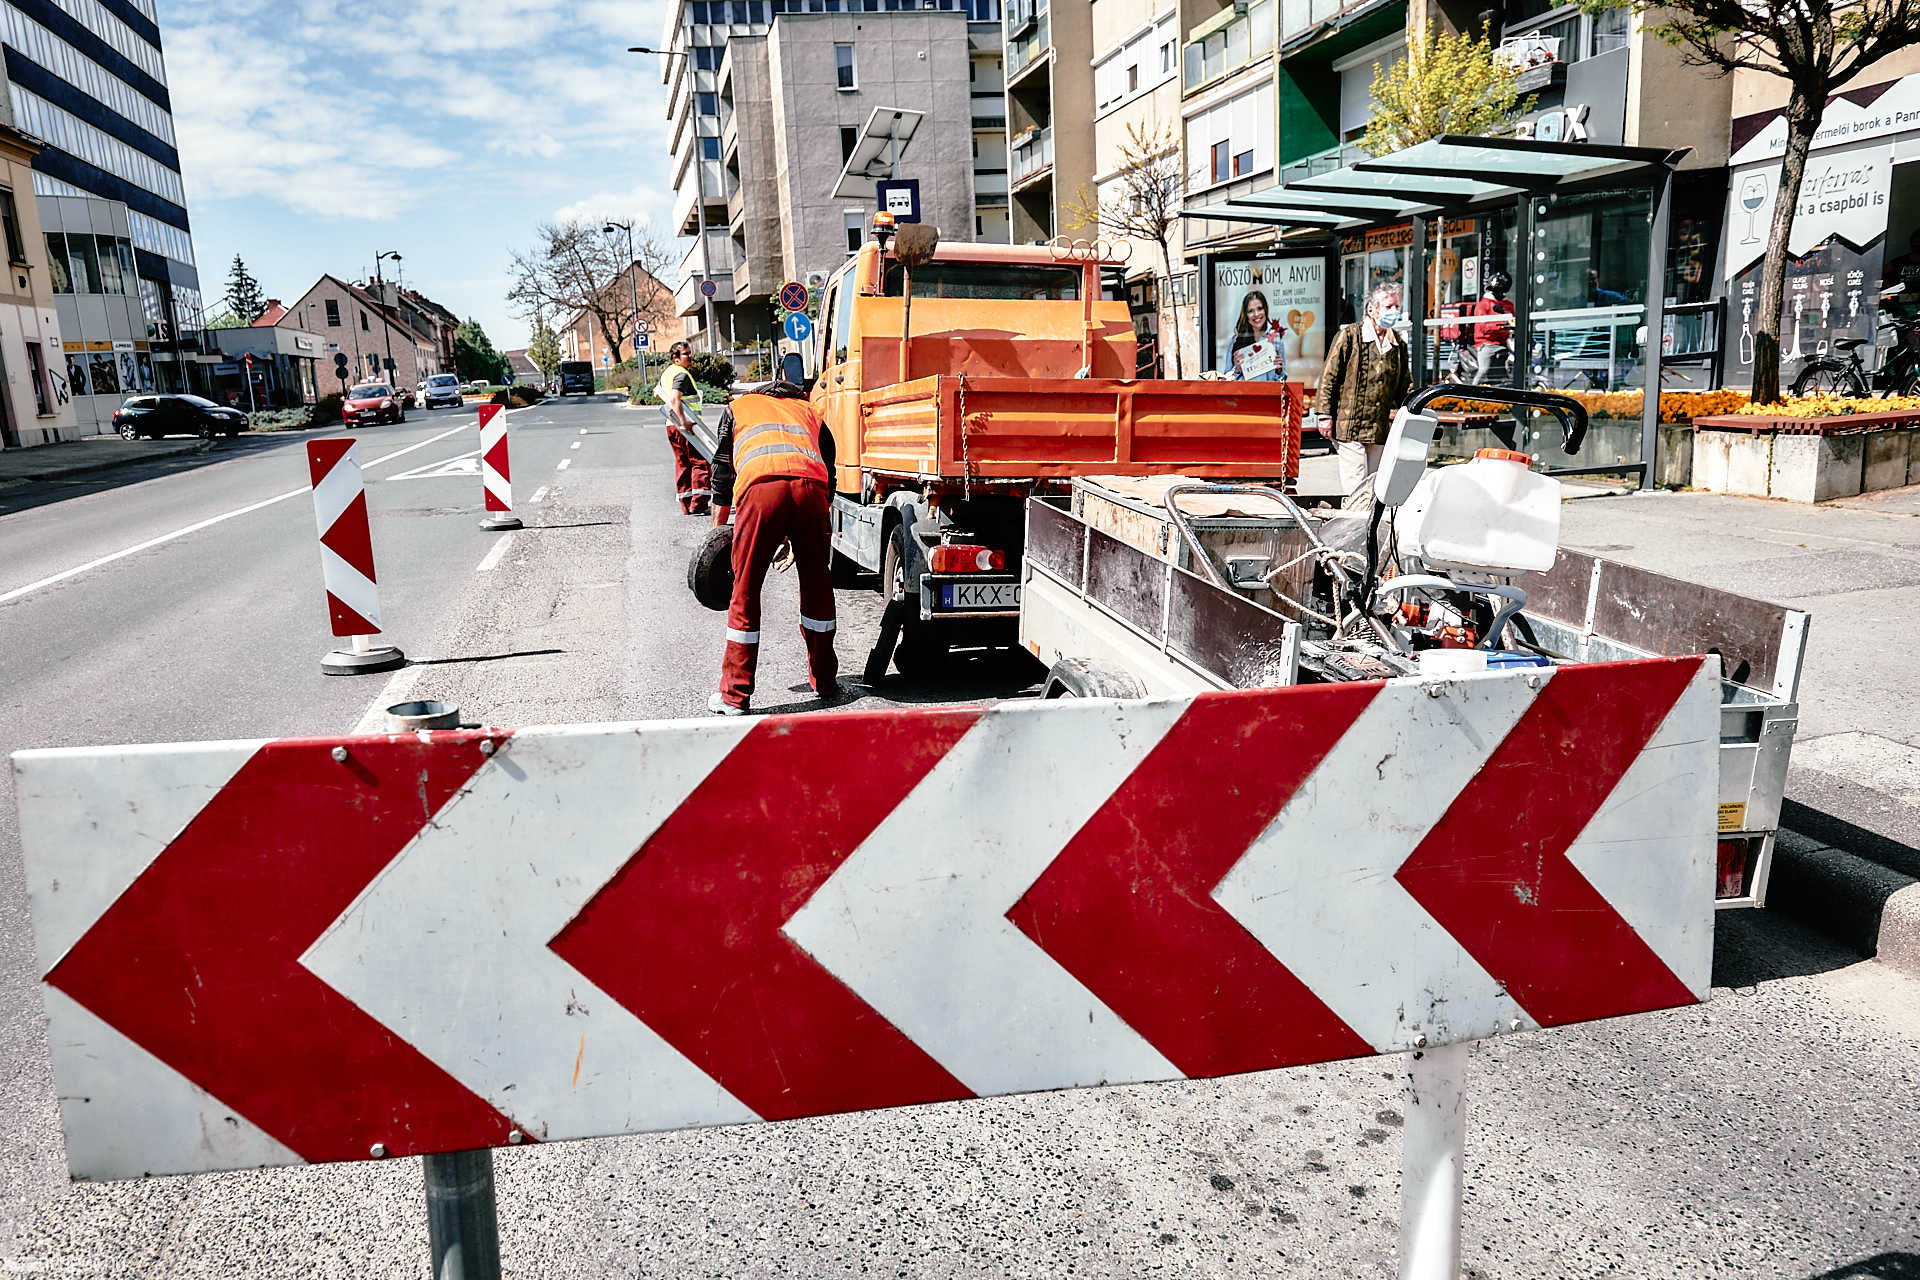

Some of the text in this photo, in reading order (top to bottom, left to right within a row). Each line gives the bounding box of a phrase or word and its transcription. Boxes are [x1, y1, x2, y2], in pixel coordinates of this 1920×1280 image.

[1853, 116, 1881, 133] borok
[1885, 116, 1892, 126] a
[1808, 204, 1815, 215] a
[1820, 192, 1868, 214] csapból
[1873, 190, 1884, 205] is
[1289, 264, 1321, 283] ANYU!
[638, 335, 646, 346] P
[944, 597, 951, 605] H
[958, 584, 1021, 605] KKX-0
